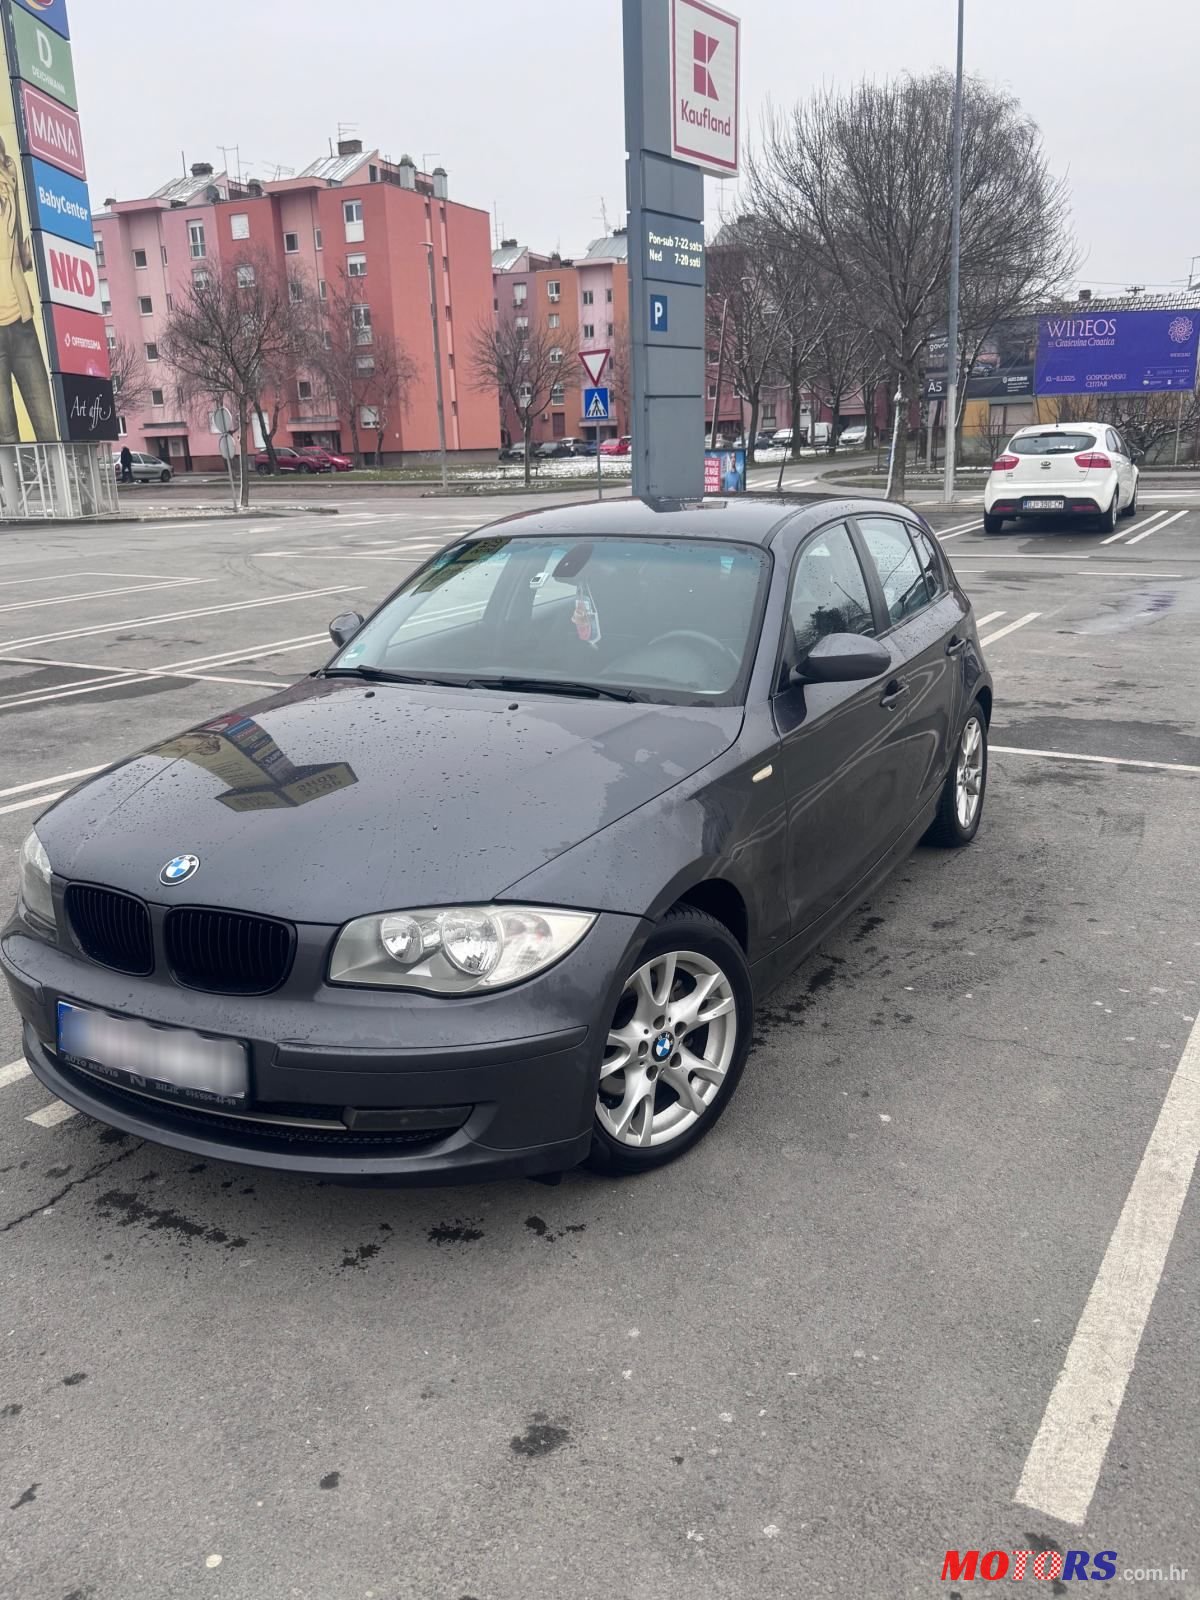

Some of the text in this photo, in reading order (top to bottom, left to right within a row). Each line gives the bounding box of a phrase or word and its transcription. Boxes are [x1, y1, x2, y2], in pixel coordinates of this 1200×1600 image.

[681, 98, 731, 137] Kaufland
[31, 106, 78, 157] MANA
[38, 186, 88, 221] BabyCenter
[648, 231, 674, 247] Pon-sub
[649, 248, 663, 262] Ned
[689, 257, 701, 268] sati
[49, 248, 95, 297] NKD
[654, 301, 663, 325] P
[928, 381, 943, 393] A5
[70, 395, 87, 419] Art
